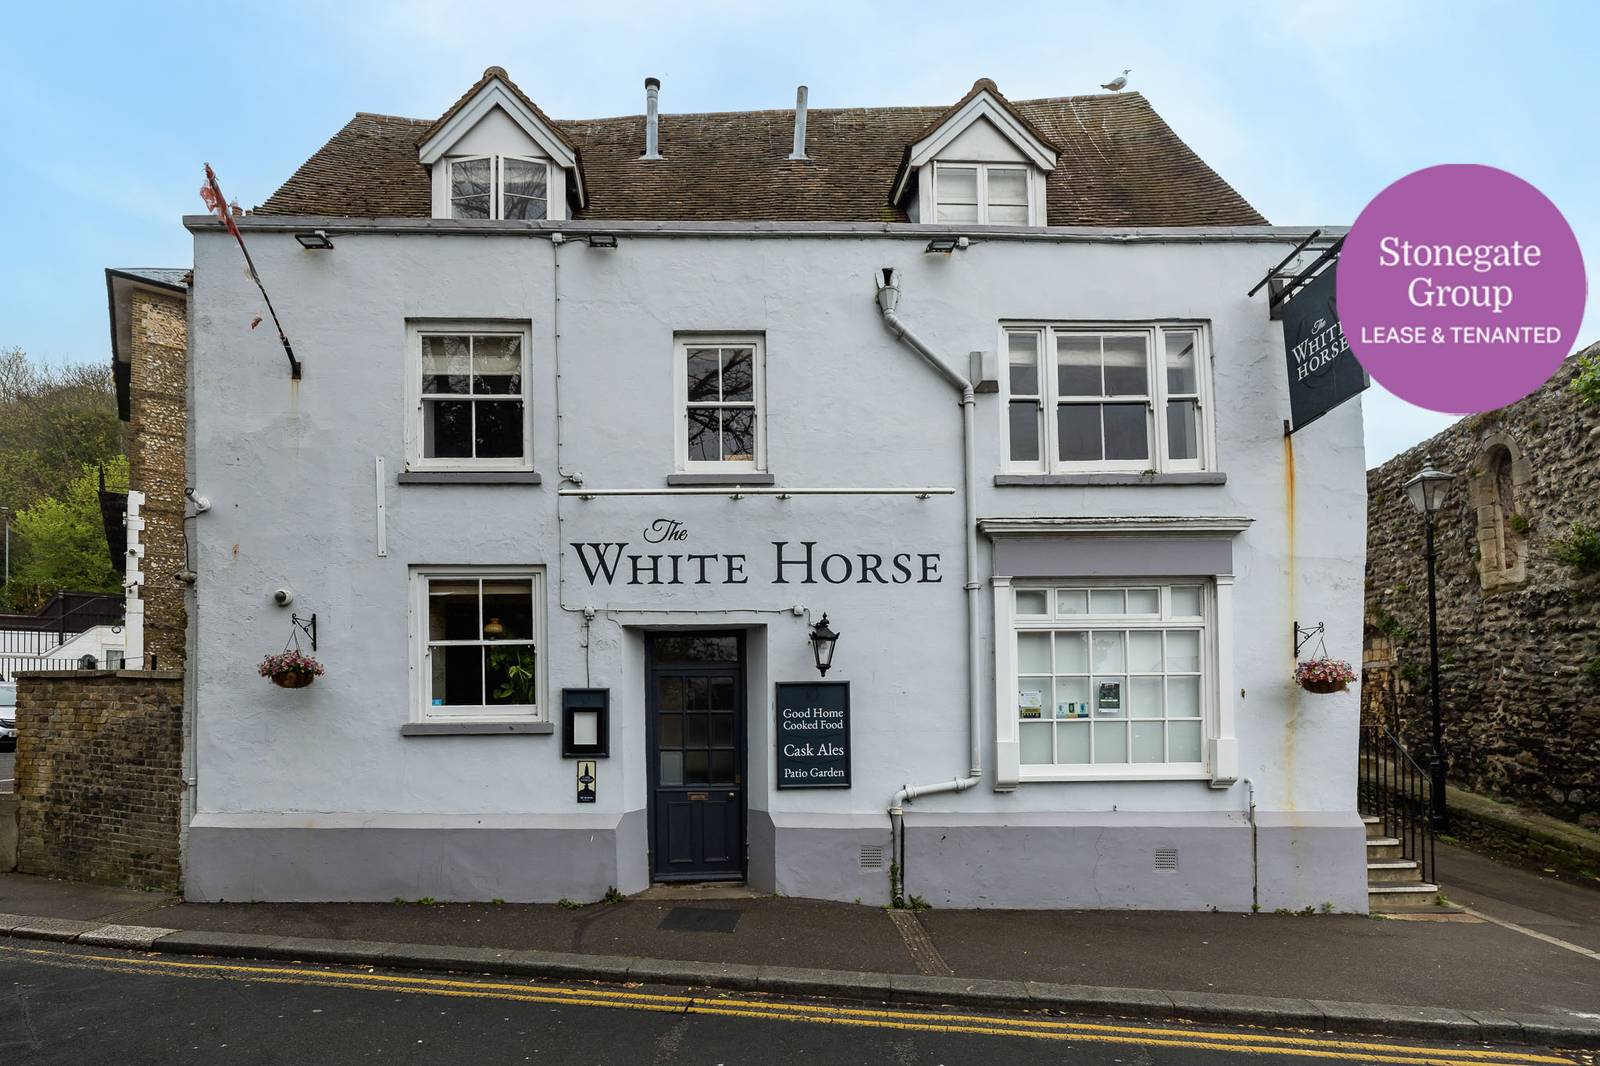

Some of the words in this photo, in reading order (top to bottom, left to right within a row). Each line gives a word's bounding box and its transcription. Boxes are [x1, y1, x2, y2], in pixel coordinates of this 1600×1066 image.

[1311, 318, 1326, 335] The
[1297, 336, 1350, 381] HORSE
[643, 518, 688, 544] The
[569, 541, 749, 586] WHITE
[771, 541, 943, 585] HORSE
[783, 708, 811, 719] Good
[813, 707, 844, 718] Home
[783, 720, 818, 730] Cooked
[820, 719, 844, 730] Food
[783, 743, 815, 757] Cask
[816, 742, 845, 756] Ales
[784, 768, 808, 778] Patio
[809, 767, 845, 778] Garden
